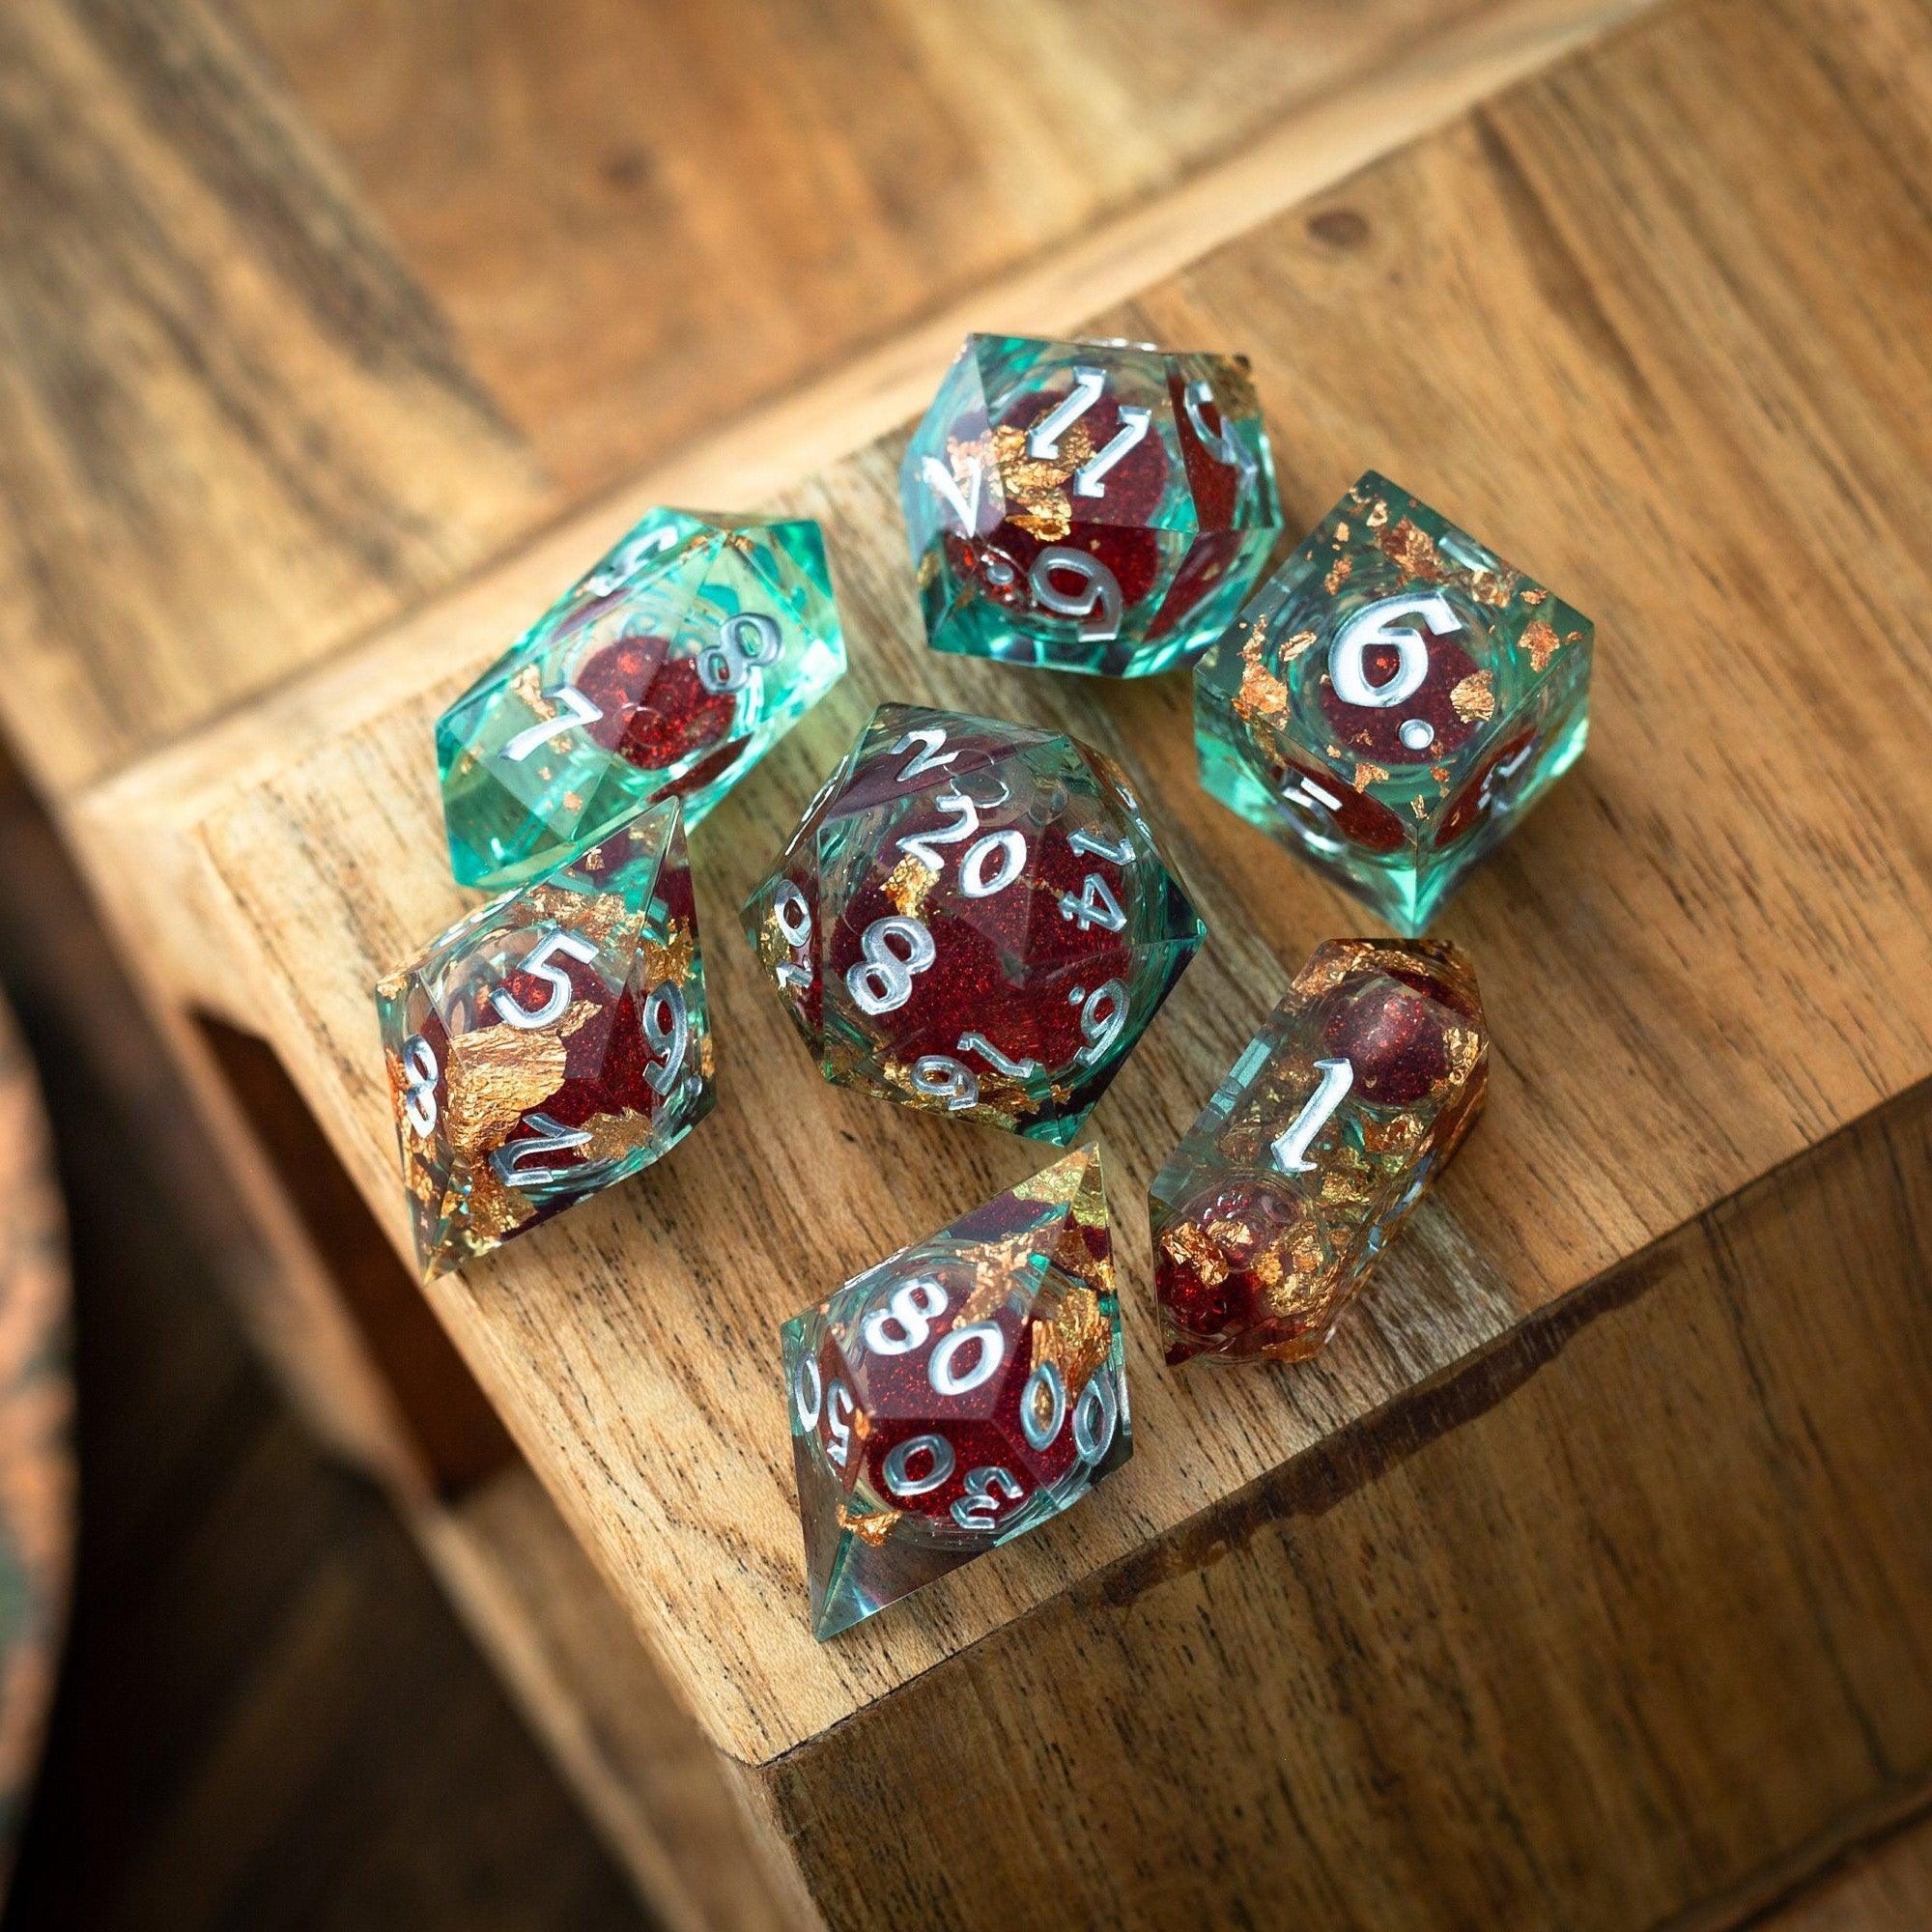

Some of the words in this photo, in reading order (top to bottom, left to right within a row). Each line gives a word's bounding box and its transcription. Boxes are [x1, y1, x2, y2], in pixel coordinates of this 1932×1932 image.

[1027, 366, 1151, 498] 11
[696, 612, 784, 695] 8
[498, 683, 604, 761] 7
[890, 728, 959, 781] 2
[895, 795, 1027, 897] 20
[1059, 828, 1136, 933] 14
[489, 926, 600, 1030] 5
[846, 916, 936, 1015] 8
[404, 1035, 439, 1139] 8
[1270, 1057, 1354, 1173] 1
[864, 1277, 1006, 1397] 80
